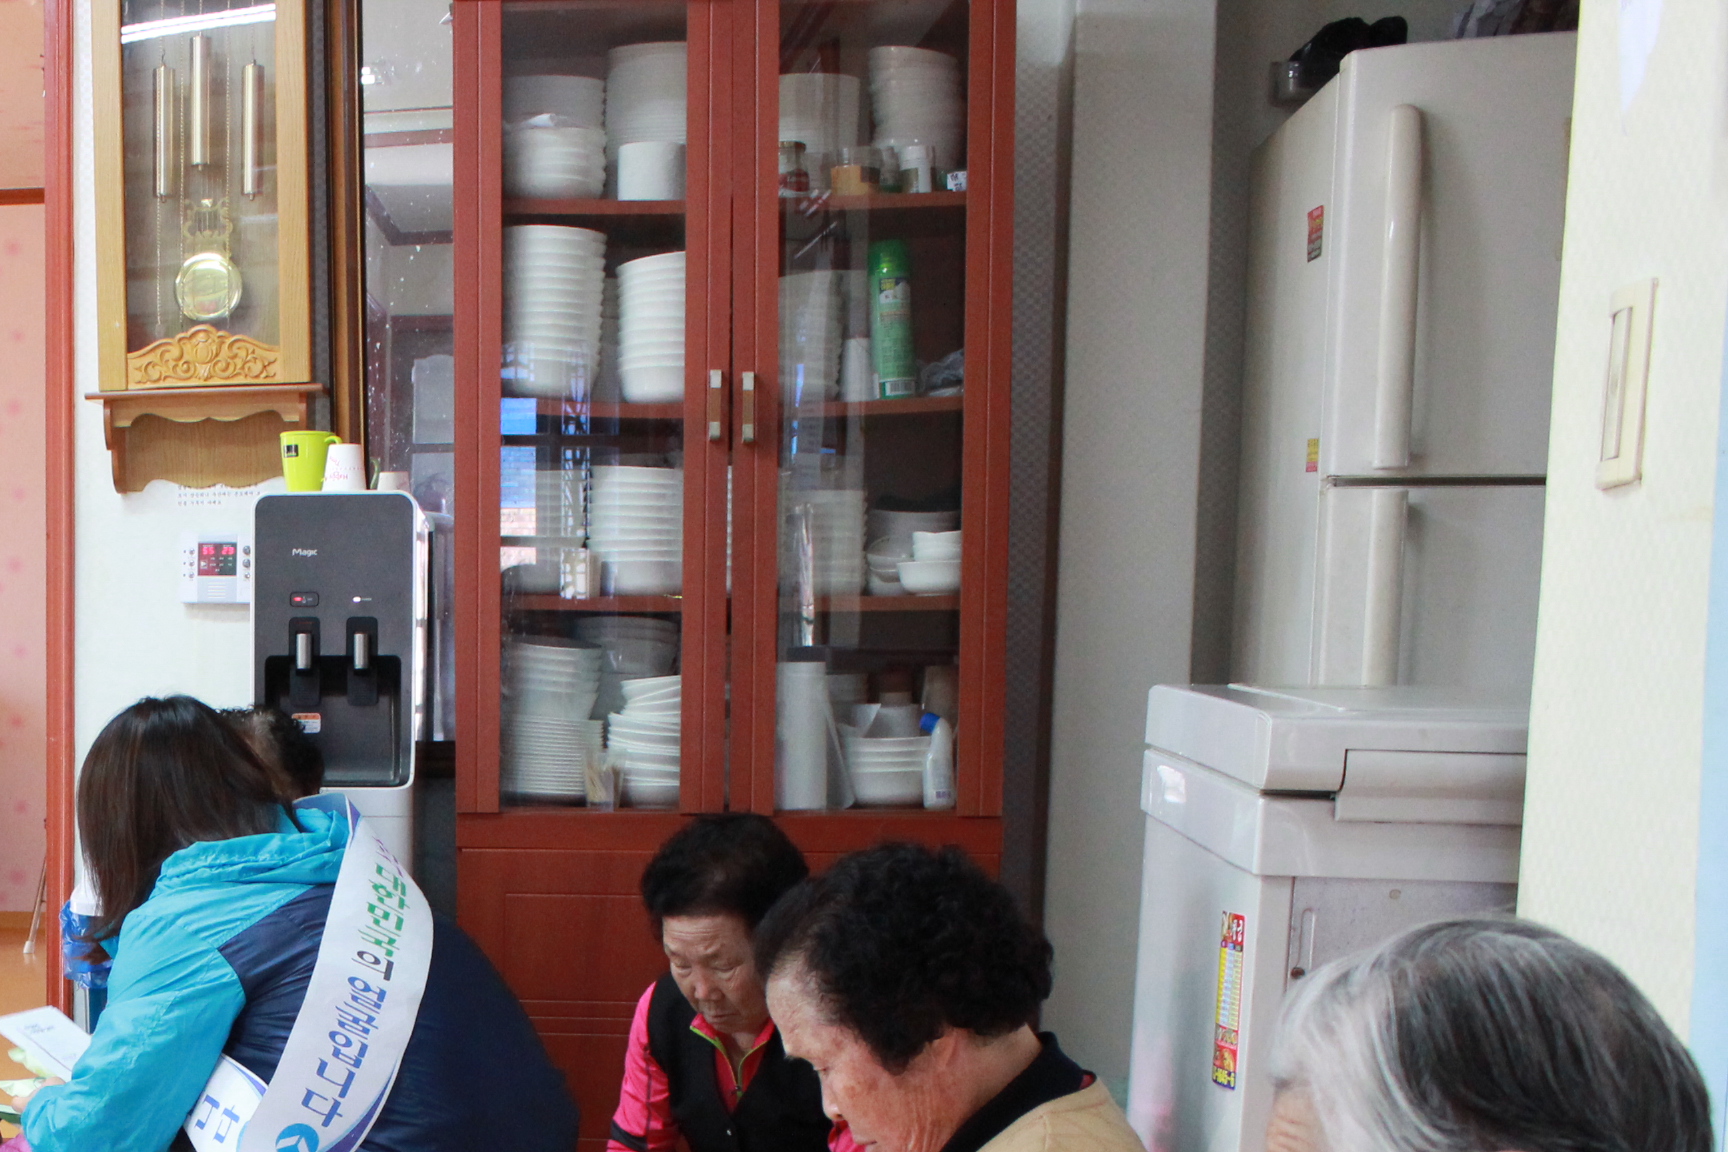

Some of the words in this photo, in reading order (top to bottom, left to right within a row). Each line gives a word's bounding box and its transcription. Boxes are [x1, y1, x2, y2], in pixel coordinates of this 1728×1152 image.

[292, 548, 318, 557] Magic
[351, 863, 410, 981] 대한민국의
[301, 976, 387, 1128] 얼굴입니다
